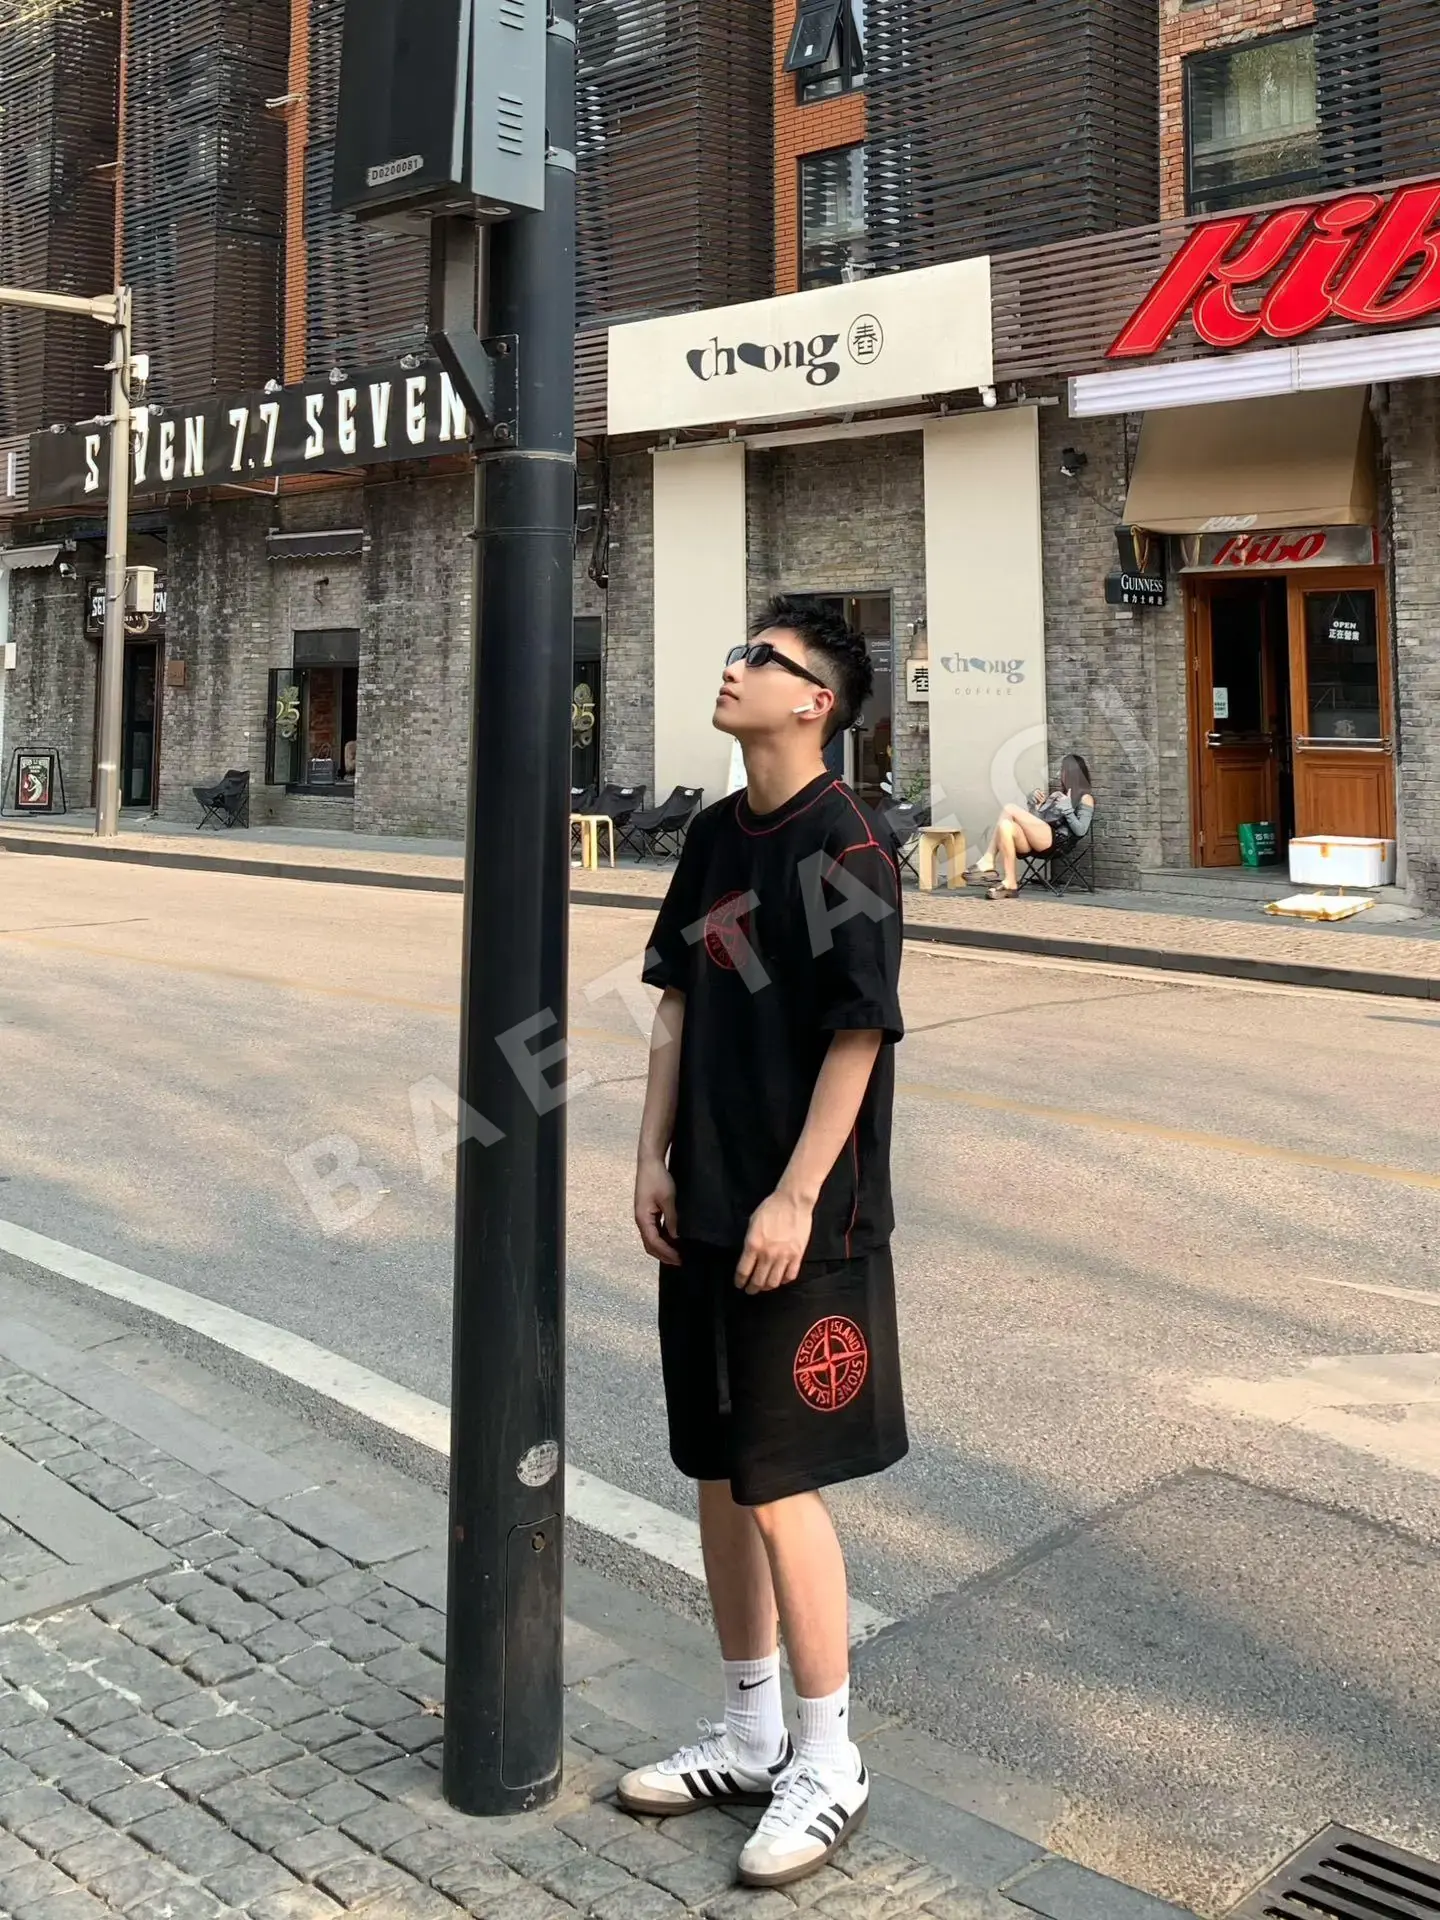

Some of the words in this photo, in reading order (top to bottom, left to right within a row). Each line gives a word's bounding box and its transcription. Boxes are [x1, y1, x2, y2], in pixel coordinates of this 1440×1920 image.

[84, 410, 206, 494] SVEN
[228, 402, 280, 472] 7.7
[304, 370, 469, 461] SEVEN
[1333, 620, 1357, 630] OPEN
[798, 1323, 826, 1364] STONE
[830, 1320, 861, 1352] ISLAND
[800, 1370, 830, 1404] ISLAND
[837, 1360, 863, 1401] STONE
